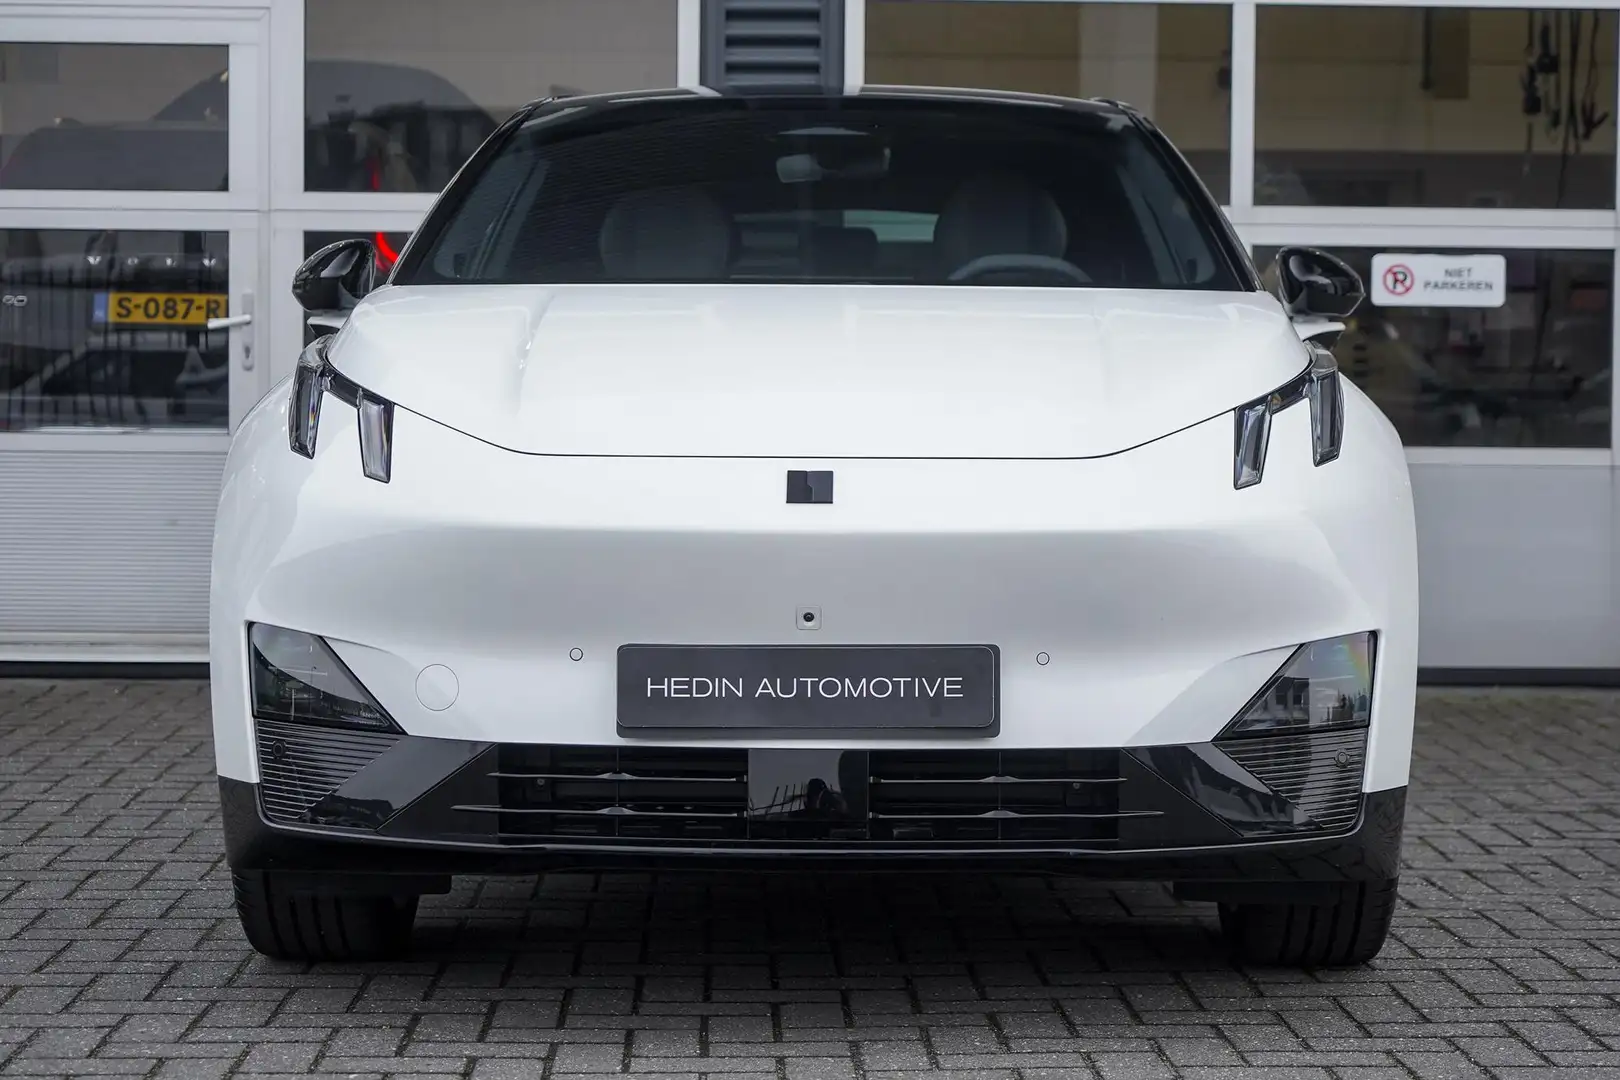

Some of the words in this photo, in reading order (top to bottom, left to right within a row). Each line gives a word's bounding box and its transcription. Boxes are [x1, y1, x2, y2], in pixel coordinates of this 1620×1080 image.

[1444, 267, 1473, 278] NIET
[1423, 280, 1493, 291] PARKEREN
[646, 677, 743, 698] HEDIN
[754, 677, 964, 698] AUTOMOTIVE
